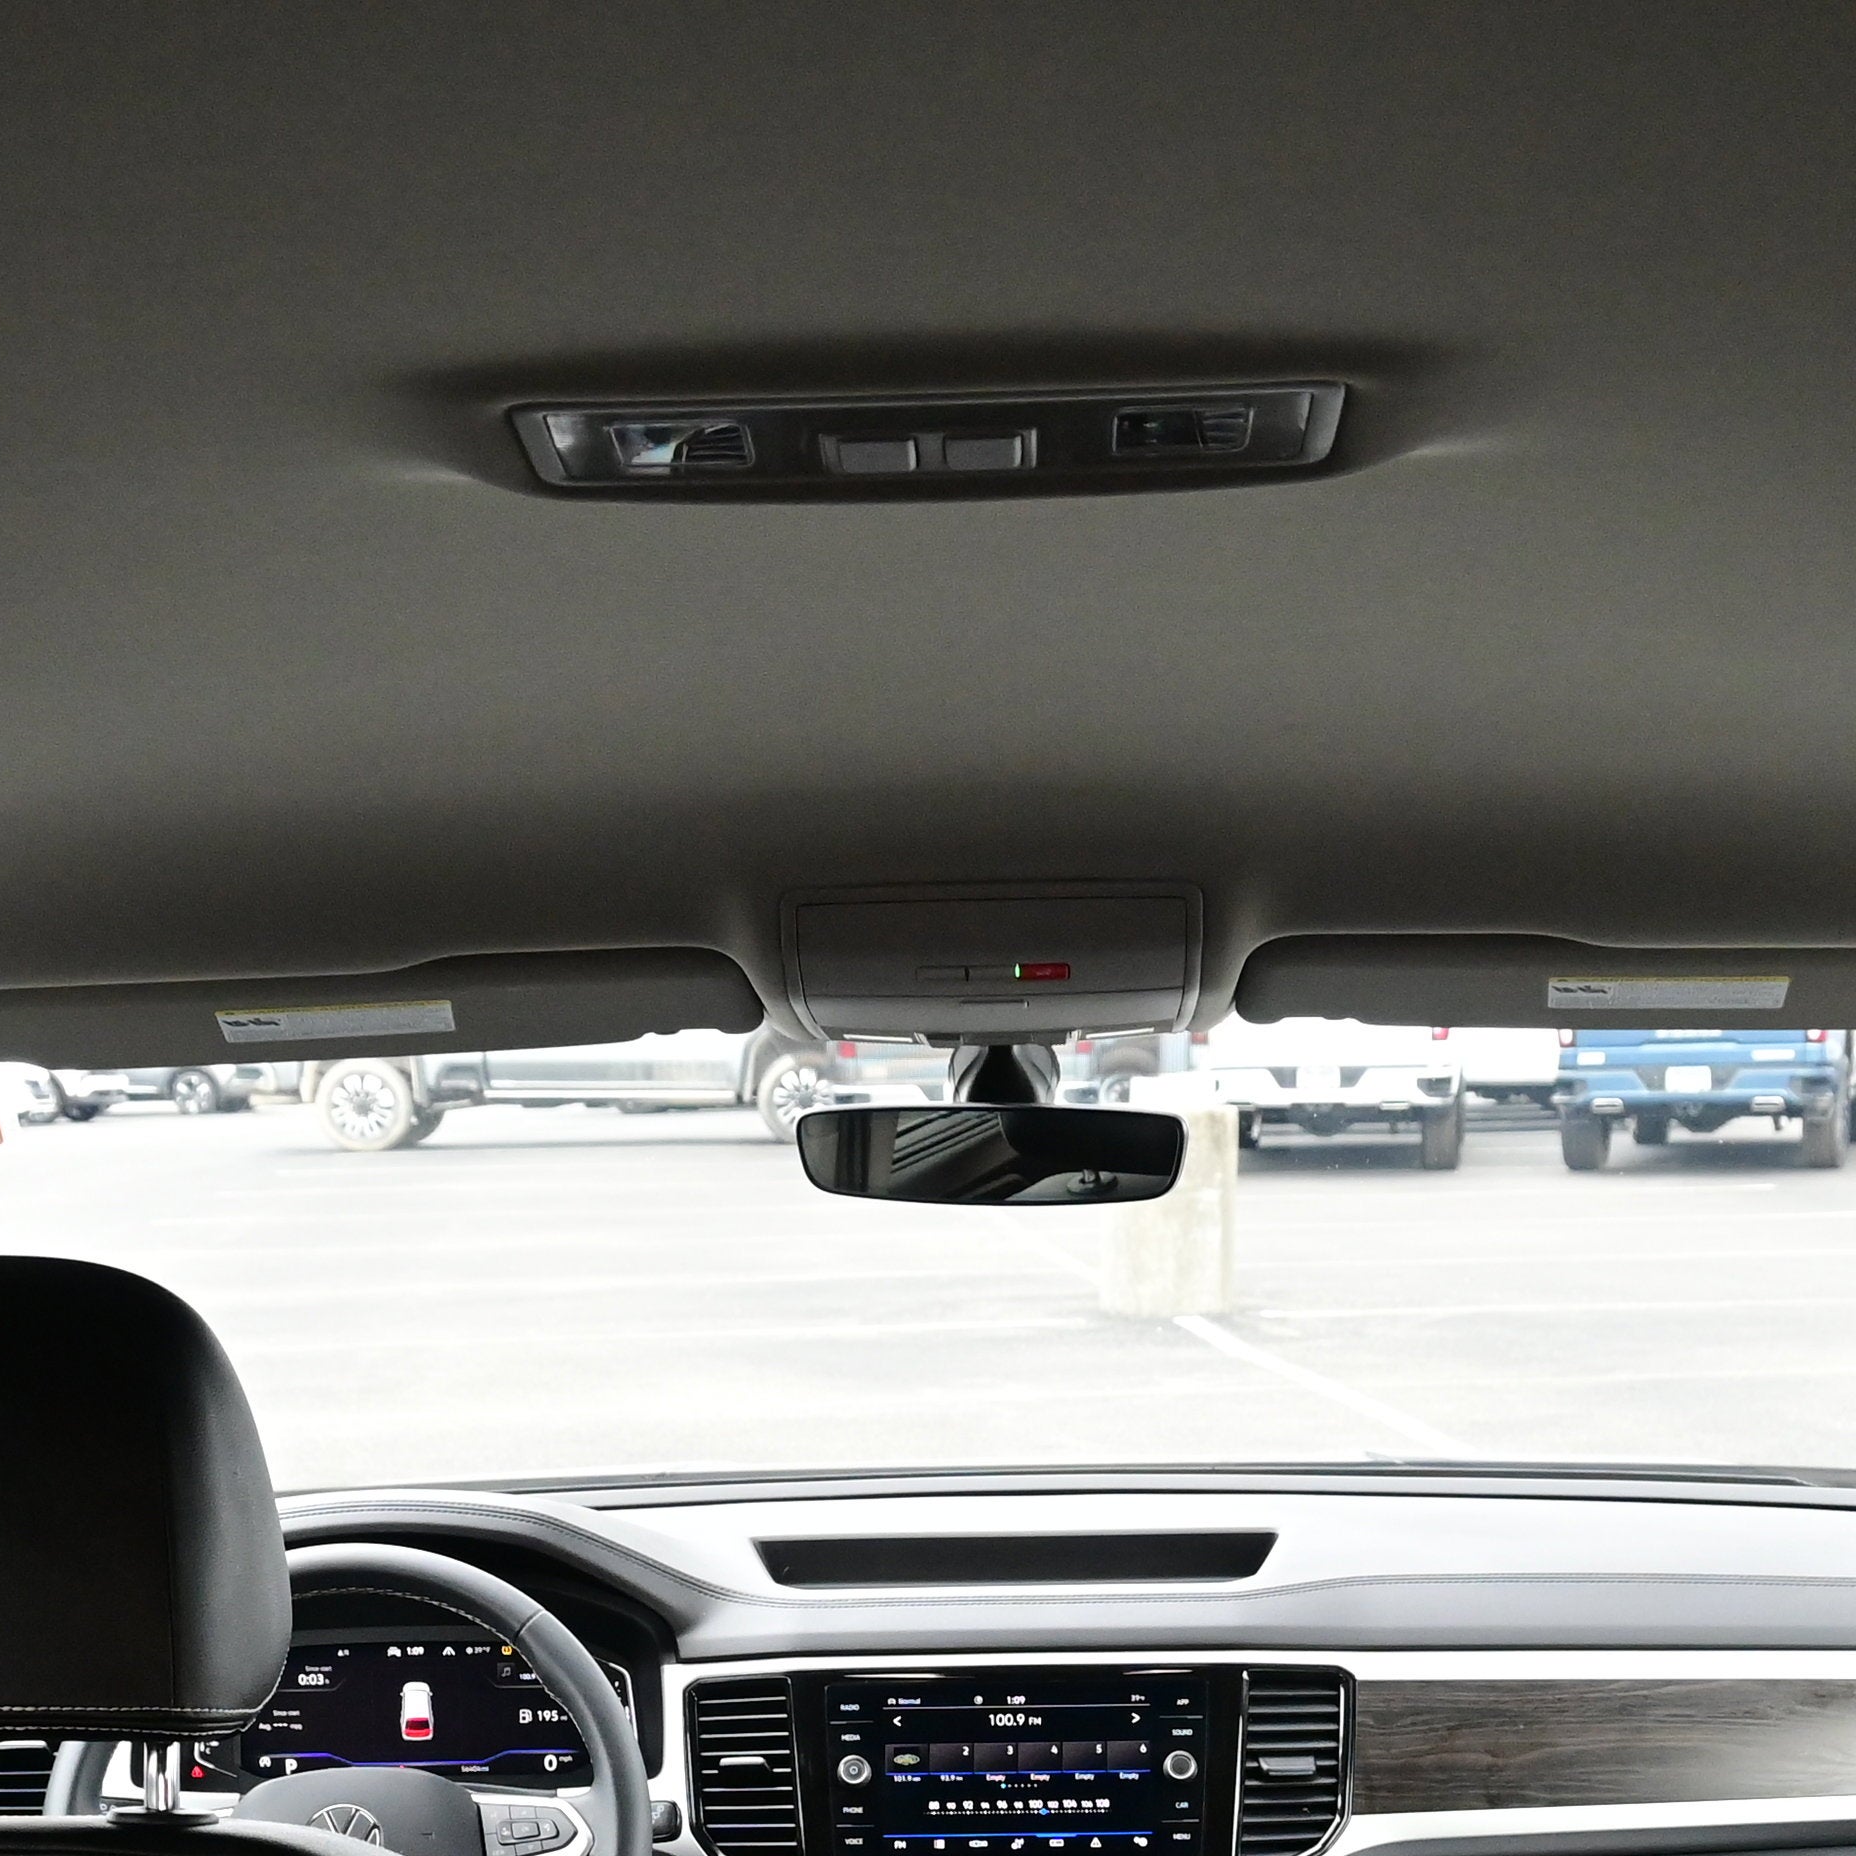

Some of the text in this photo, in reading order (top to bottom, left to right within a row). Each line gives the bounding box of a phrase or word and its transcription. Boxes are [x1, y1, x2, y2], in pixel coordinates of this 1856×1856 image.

[297, 1673, 324, 1685] 0:03
[1006, 1695, 1025, 1704] 1:09
[839, 1703, 860, 1711] RADIO
[536, 1709, 558, 1722] 195
[988, 1713, 1042, 1726] 100.9 FM
[1171, 1728, 1193, 1736] SOUND
[840, 1733, 861, 1741] MEDIA
[962, 1745, 970, 1756] 2
[1006, 1745, 1014, 1755] 3
[1050, 1744, 1058, 1754] 4
[1095, 1743, 1103, 1754] 5
[1139, 1743, 1147, 1753] 6
[284, 1758, 298, 1775] P
[985, 1773, 1006, 1782] Empty
[1030, 1772, 1050, 1781] Empty
[1074, 1772, 1094, 1780] Empty
[1119, 1772, 1139, 1780] Empty
[962, 1799, 973, 1810] 92
[1028, 1799, 1043, 1808] 100
[1062, 1798, 1077, 1808] 104
[842, 1806, 863, 1814] PHONE
[1172, 1832, 1191, 1840] MENU
[844, 1837, 863, 1845] VOICE
[893, 1839, 906, 1849] FM
